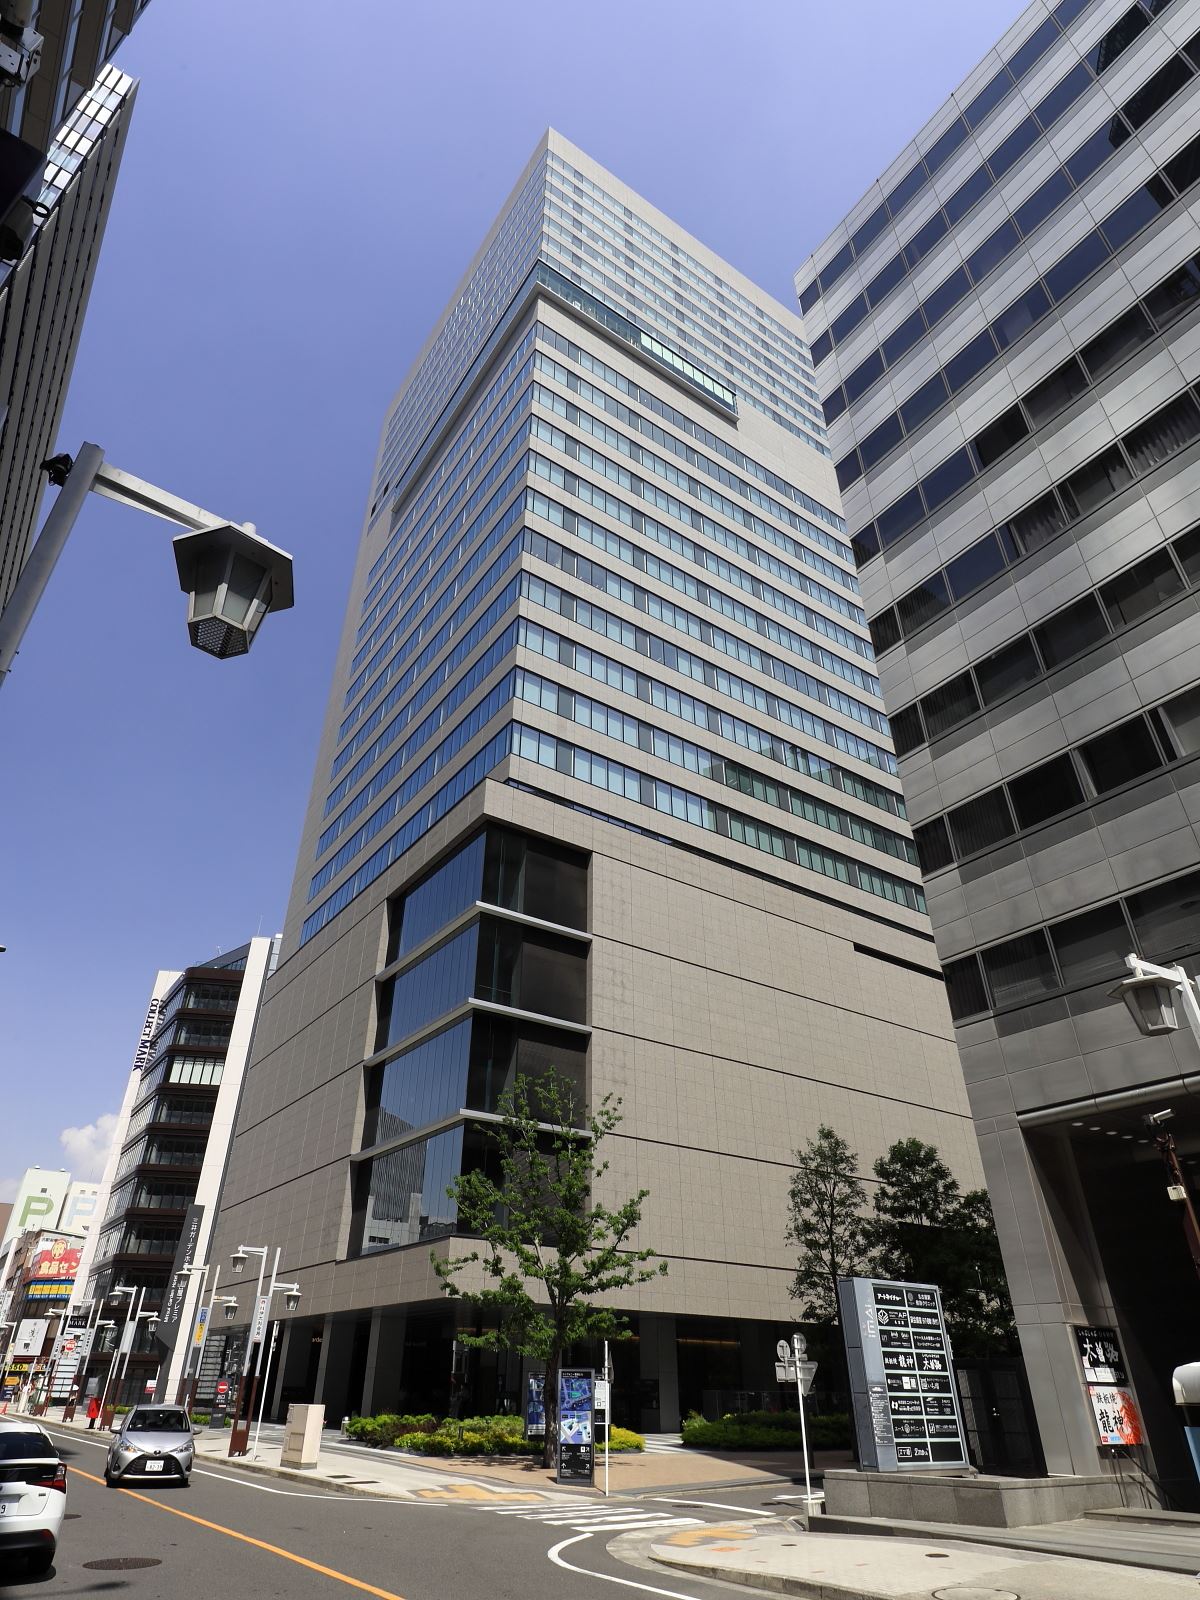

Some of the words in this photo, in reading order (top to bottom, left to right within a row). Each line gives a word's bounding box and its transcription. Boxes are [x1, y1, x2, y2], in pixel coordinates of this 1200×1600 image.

[142, 998, 159, 1038] COLLECT
[132, 1039, 151, 1071] MARK
[18, 1195, 54, 1227] P
[65, 1196, 97, 1227] P
[1098, 1408, 1124, 1434] 龍神
